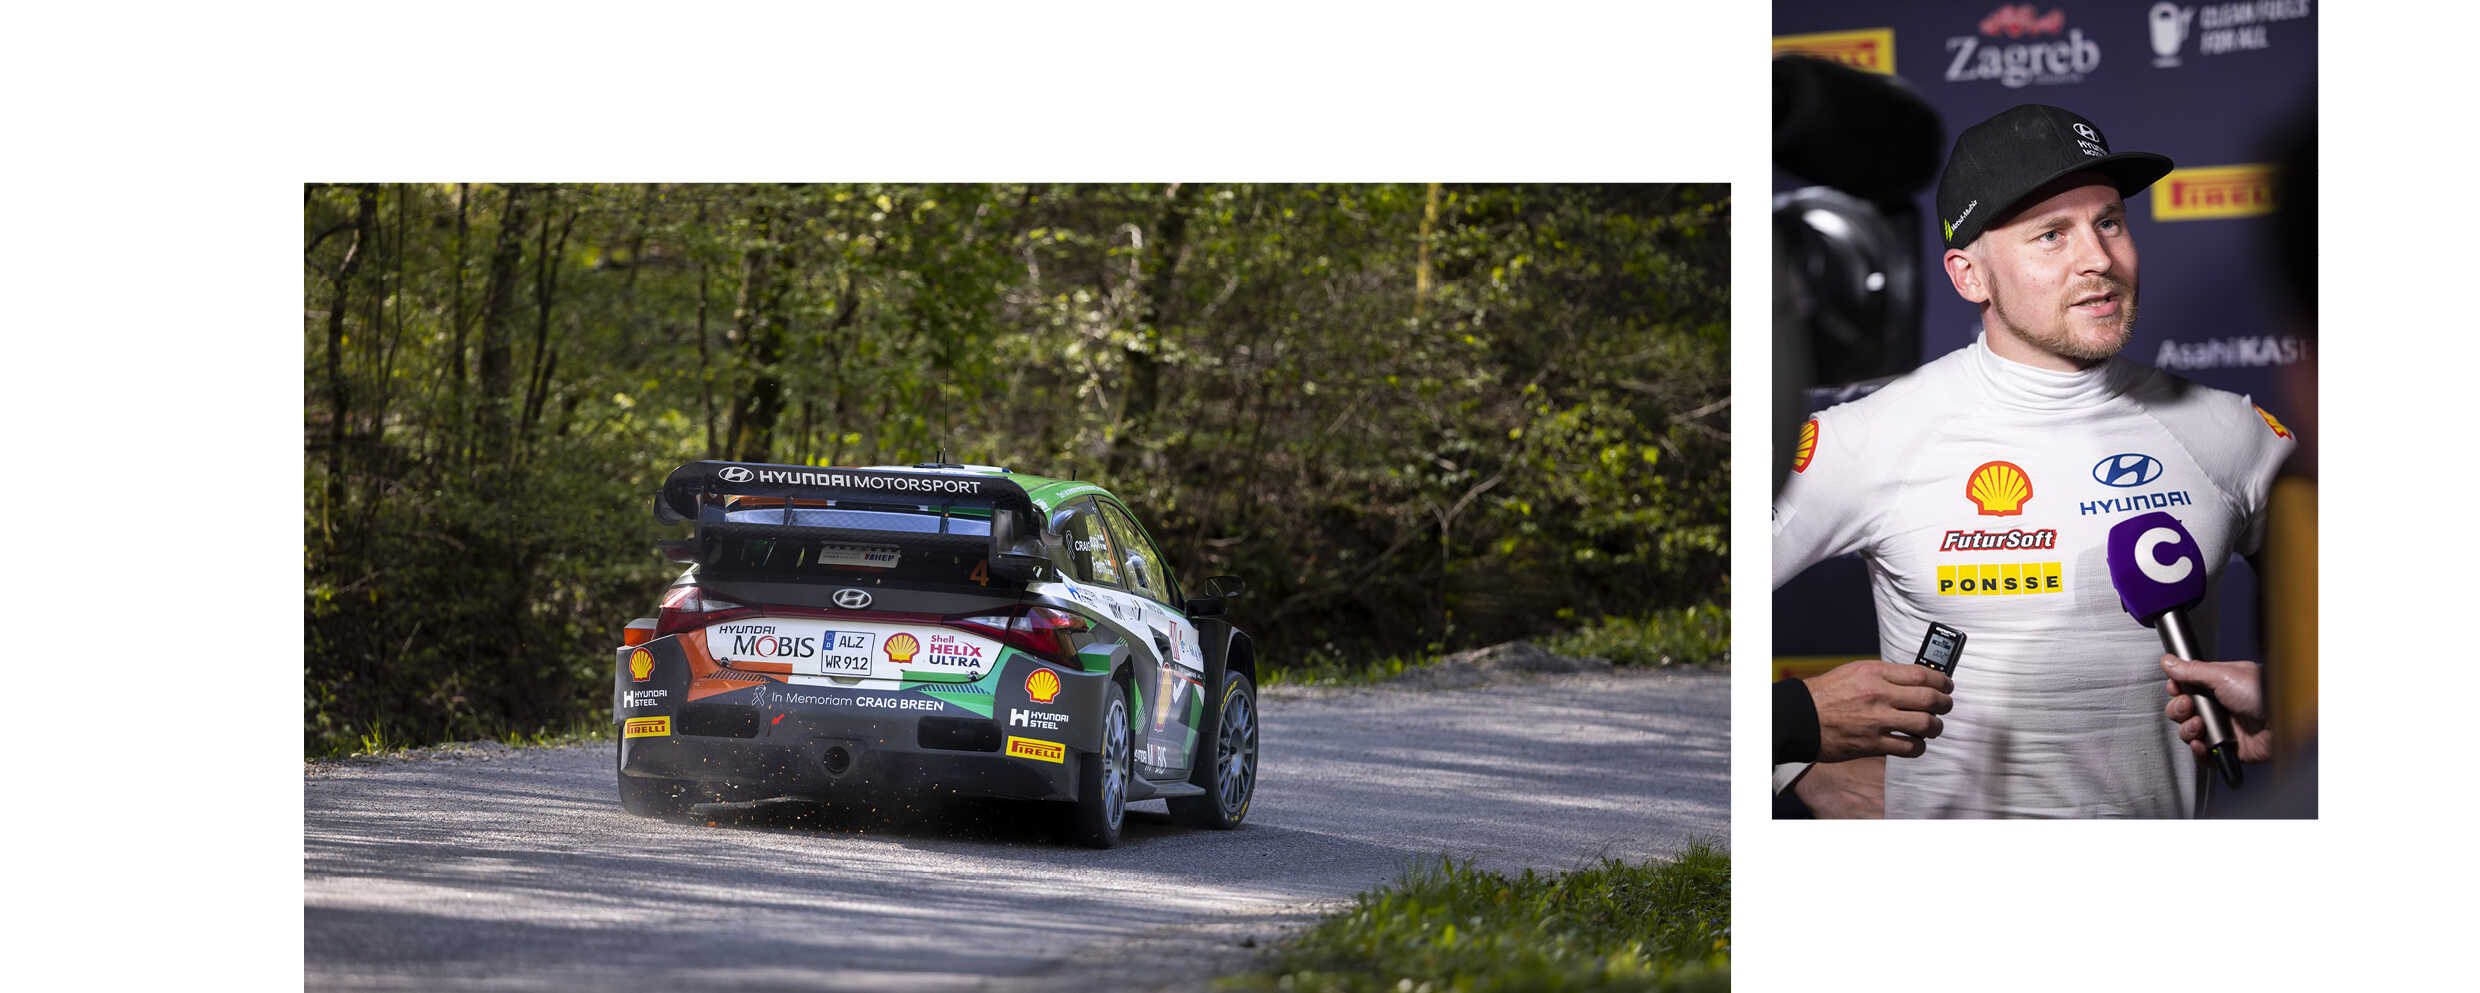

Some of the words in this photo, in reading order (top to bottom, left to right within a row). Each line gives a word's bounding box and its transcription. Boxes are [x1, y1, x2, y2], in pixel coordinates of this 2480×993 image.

[1945, 28, 2100, 88] Zagreb
[2171, 176, 2276, 208] PIREL
[759, 470, 851, 488] HYUNDAI
[854, 476, 981, 494] MOTORSPORT
[2080, 490, 2192, 516] HYUNDAI
[1941, 529, 2056, 551] FuturSoft
[969, 559, 990, 587] 4
[1940, 575, 2059, 592] PONSSE
[719, 625, 776, 635] HYUNDAI
[733, 635, 815, 658] MOBIS
[838, 636, 864, 649] ALZ
[931, 634, 955, 644] Shell
[929, 643, 982, 658] HELIX
[825, 655, 842, 669] WR
[844, 656, 868, 671] 912
[929, 655, 981, 668] ULTRA
[634, 689, 668, 698] HYUNDAI
[634, 699, 658, 707] STEEL
[771, 693, 783, 704] In
[786, 693, 853, 706] Memoriam
[856, 696, 897, 708] CRAIG
[900, 699, 944, 711] BREEN
[1030, 711, 1069, 723] HYUNDAI
[1030, 720, 1059, 730] STEEL
[627, 719, 666, 735] PIRELLI
[1012, 740, 1063, 760] PIRELLI
